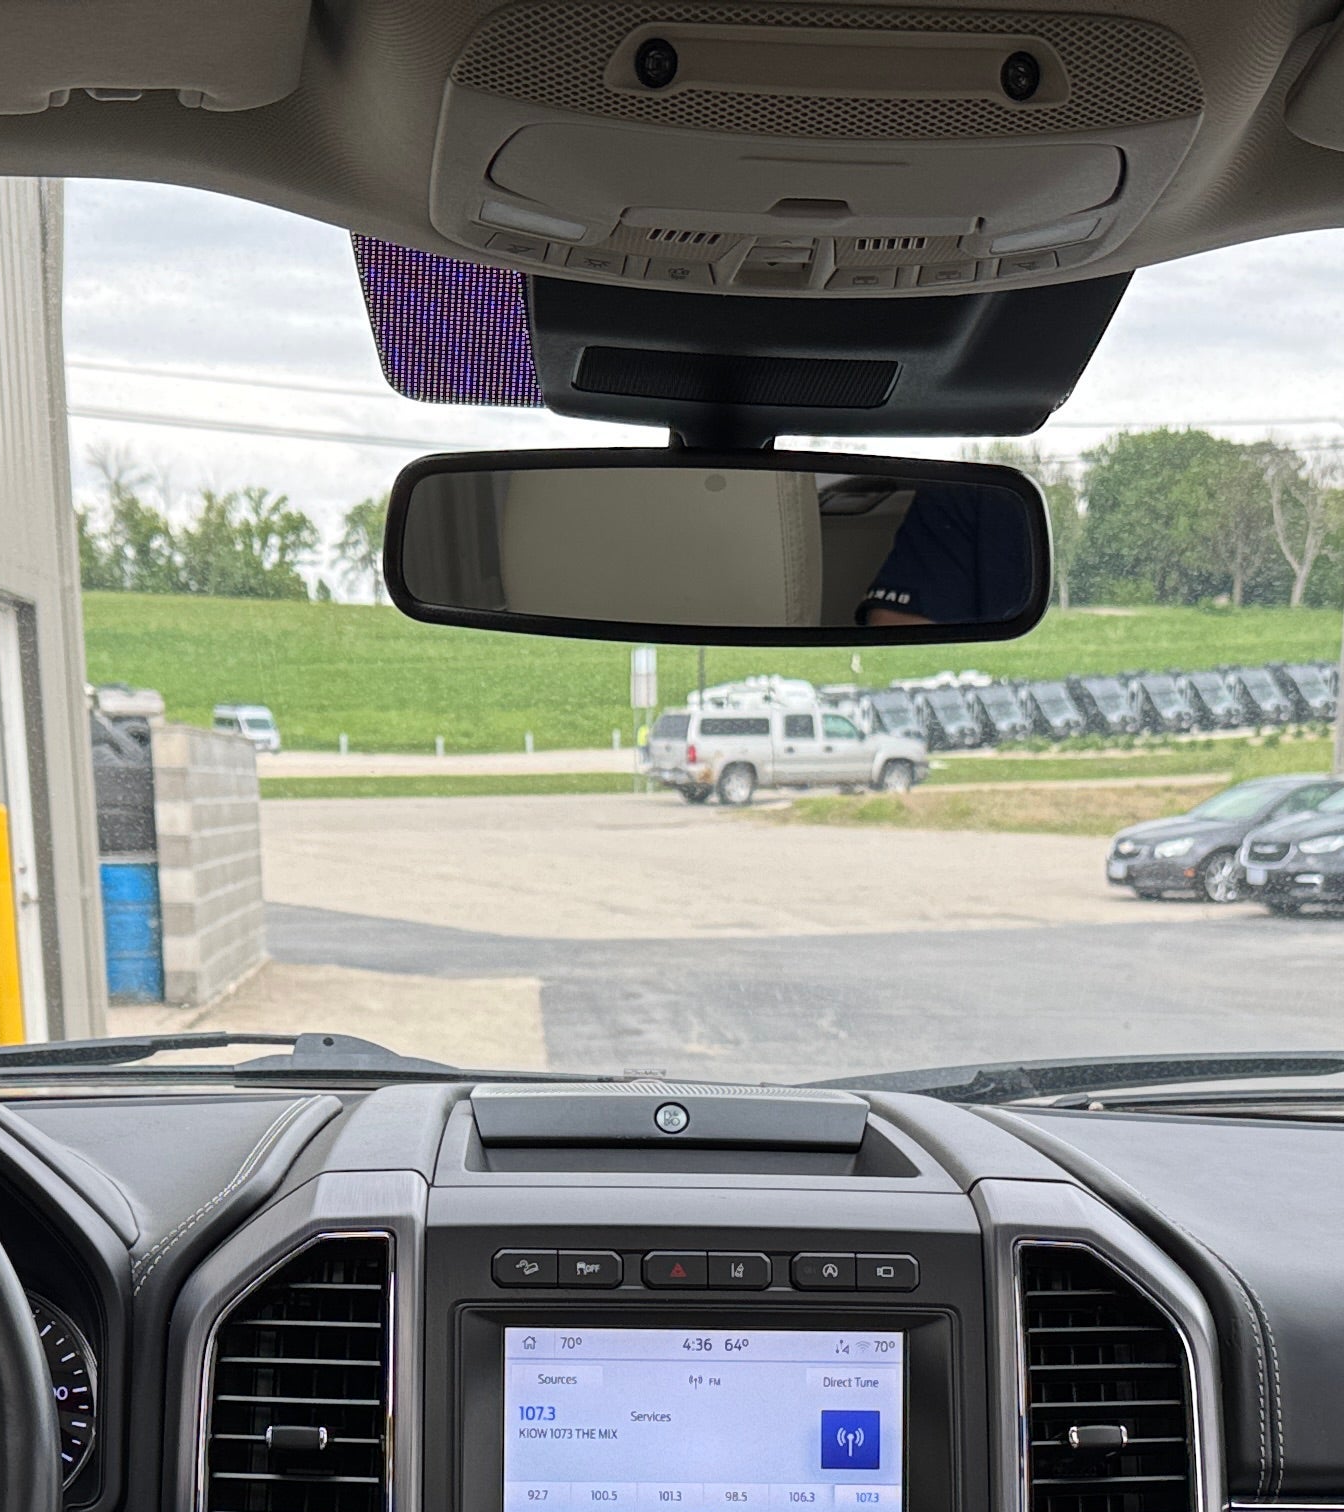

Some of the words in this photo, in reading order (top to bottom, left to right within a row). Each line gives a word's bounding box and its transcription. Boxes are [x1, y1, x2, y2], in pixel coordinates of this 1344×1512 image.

[683, 1338, 712, 1351] 4:36
[538, 1374, 577, 1385] Sources
[709, 1378, 721, 1386] FM
[823, 1377, 852, 1387] Direct
[855, 1377, 879, 1387] Tune
[519, 1406, 556, 1420] 107.3
[630, 1411, 671, 1422] Services
[550, 1428, 572, 1439] 1073
[577, 1428, 596, 1439] THE
[599, 1429, 618, 1439] MIX
[591, 1490, 618, 1501] 100.5
[659, 1491, 682, 1501] 101.3
[725, 1491, 747, 1501] 98.5
[789, 1492, 815, 1503] 106.3
[856, 1492, 879, 1503] 107.3
